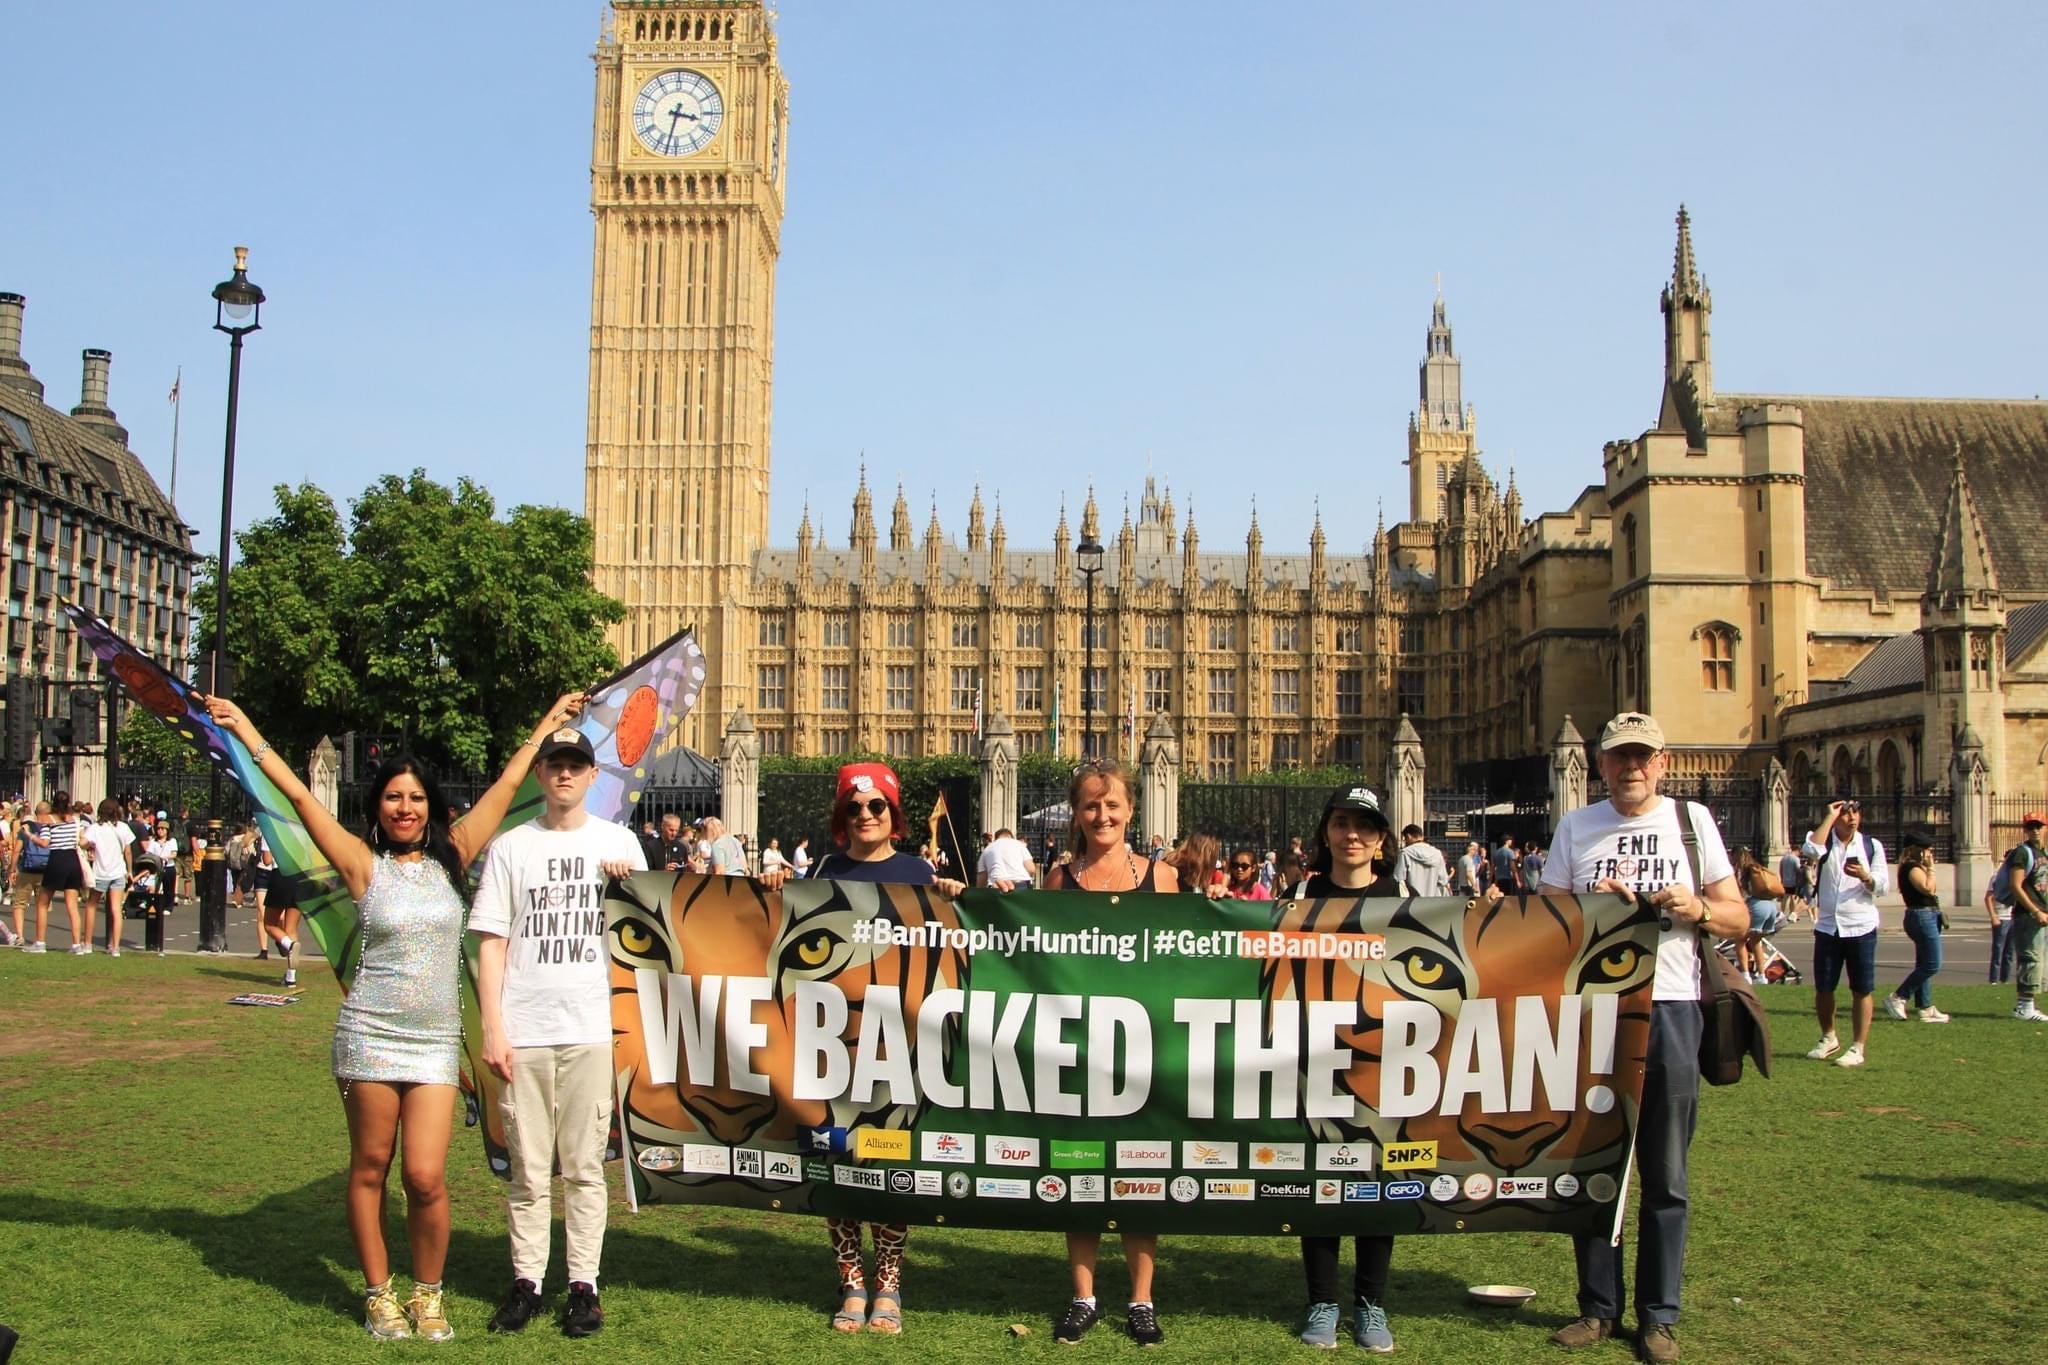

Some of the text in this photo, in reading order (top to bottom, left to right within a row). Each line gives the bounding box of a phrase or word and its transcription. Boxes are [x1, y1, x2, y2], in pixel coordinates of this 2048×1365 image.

[1617, 834, 1658, 855] END
[548, 857, 584, 882] END
[852, 918, 1137, 963] #BanTrophyHunting
[1154, 929, 1385, 960] #GetTheBanDone
[537, 938, 585, 964] NOW
[634, 967, 1620, 1120] WE BACKED THE BAN!
[865, 1138, 903, 1150] Alliance
[736, 1149, 759, 1163] ANIMAL
[1001, 1149, 1031, 1160] DUP
[1130, 1150, 1167, 1159] Labour
[1277, 1156, 1300, 1164] Cymru
[1388, 1149, 1420, 1163] SNP
[1329, 1157, 1358, 1165] SDLP
[748, 1163, 760, 1175] AID
[860, 1172, 881, 1186] FREE
[1261, 1184, 1310, 1195] OneKind
[1390, 1185, 1420, 1195] RSPCA
[1517, 1182, 1544, 1191] WCF
